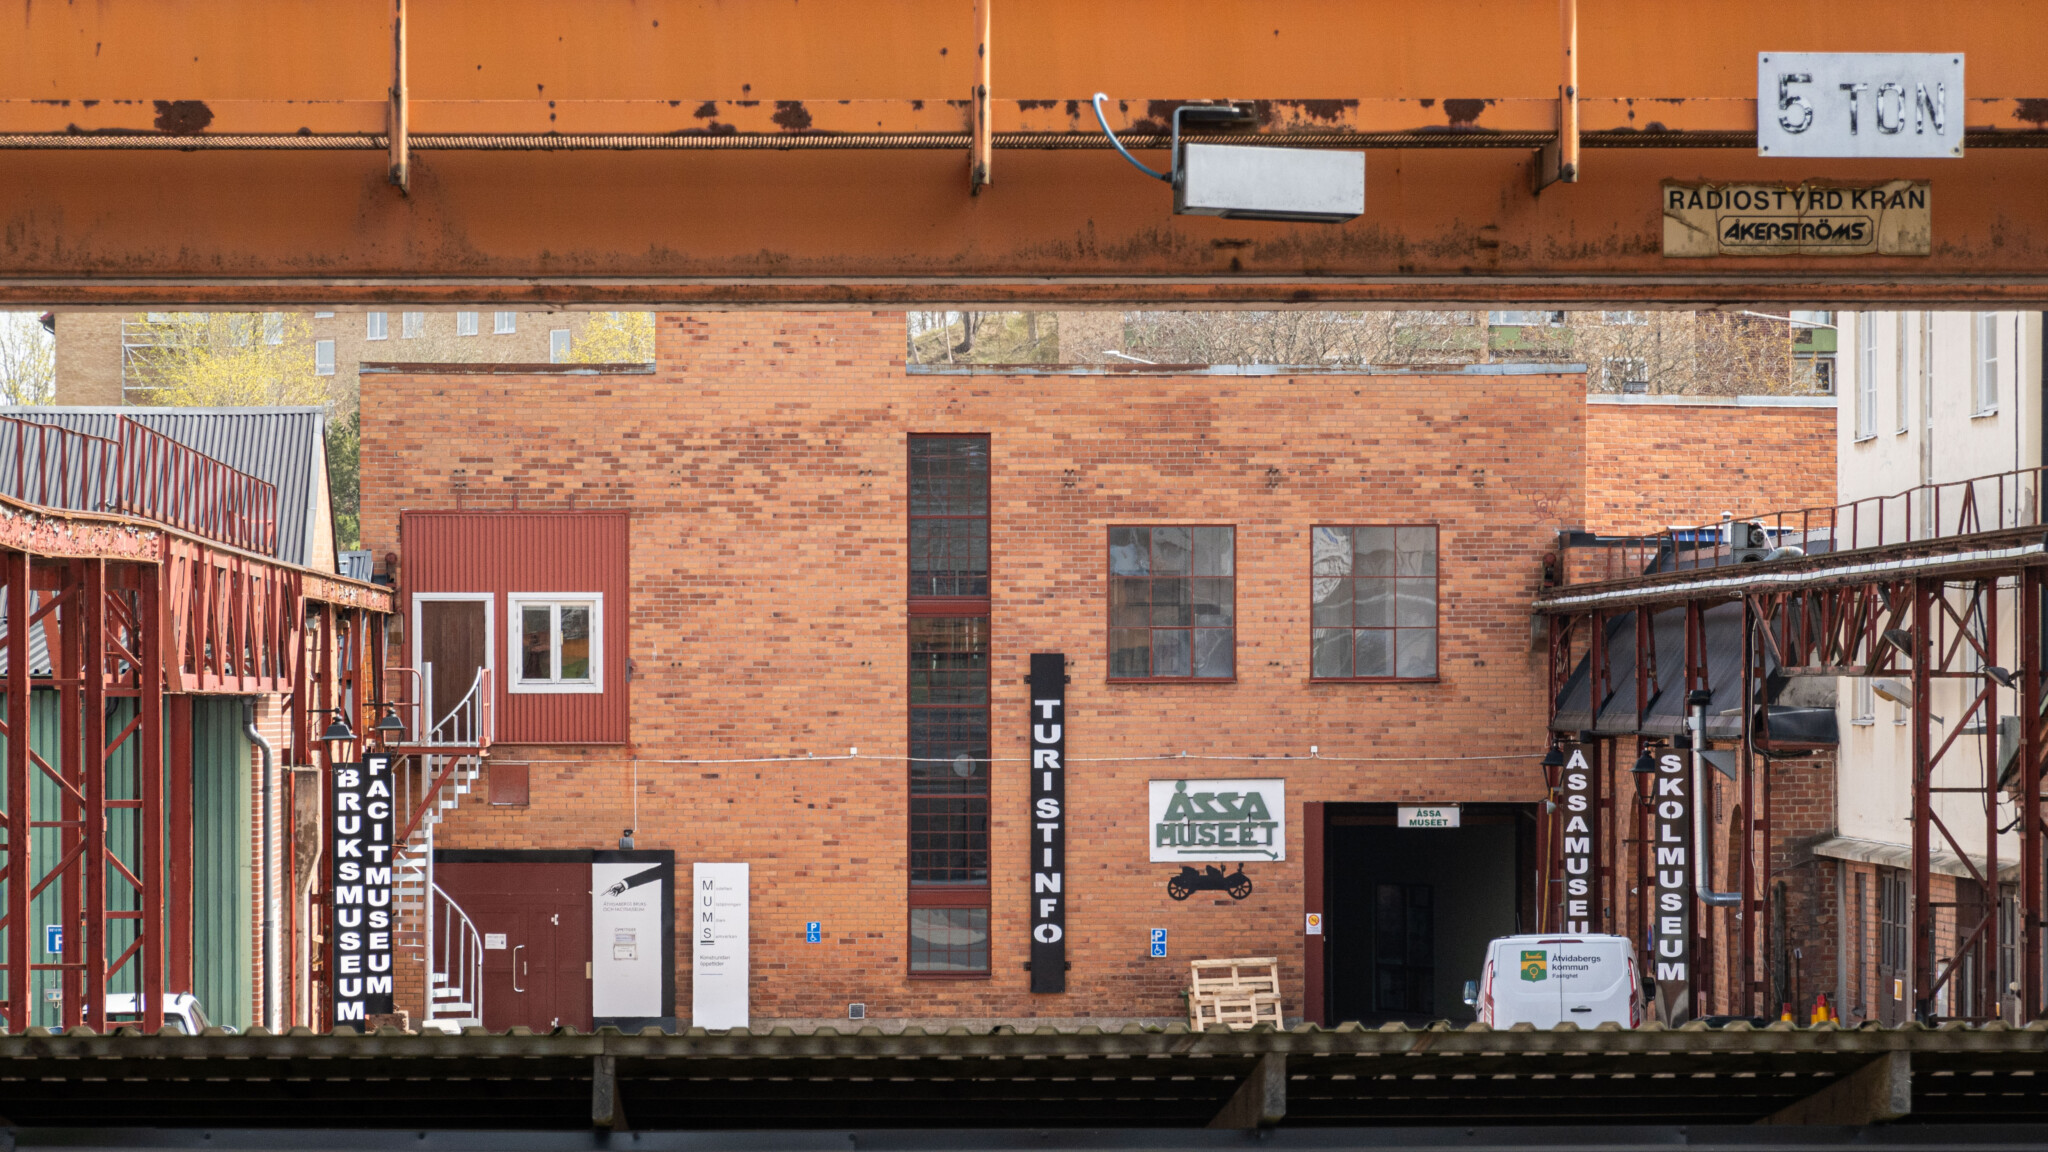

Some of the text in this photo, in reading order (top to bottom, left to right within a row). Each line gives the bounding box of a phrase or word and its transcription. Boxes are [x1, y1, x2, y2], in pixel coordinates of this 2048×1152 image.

[1778, 73, 1945, 136] 5 TON
[1669, 190, 1926, 210] RADIOSTYRD KRAN
[1723, 218, 1867, 241] ÅKERSTRÖMS
[1163, 780, 1271, 821] ÅSSA
[1416, 808, 1442, 818] ÅSSA
[1034, 699, 1063, 944] TURISTINFO
[1156, 821, 1279, 848] MUSEET
[1409, 818, 1449, 827] MUSEET
[1565, 749, 1590, 934] ÅSSAMUSEU
[365, 758, 393, 995] FACITMUSEUM
[1657, 754, 1686, 982] SKOLMUSEUM
[336, 769, 365, 1021] BRUKSMUSEUM
[811, 922, 817, 931] P
[1155, 930, 1163, 942] P
[1552, 953, 1601, 963] Åtvidabergs
